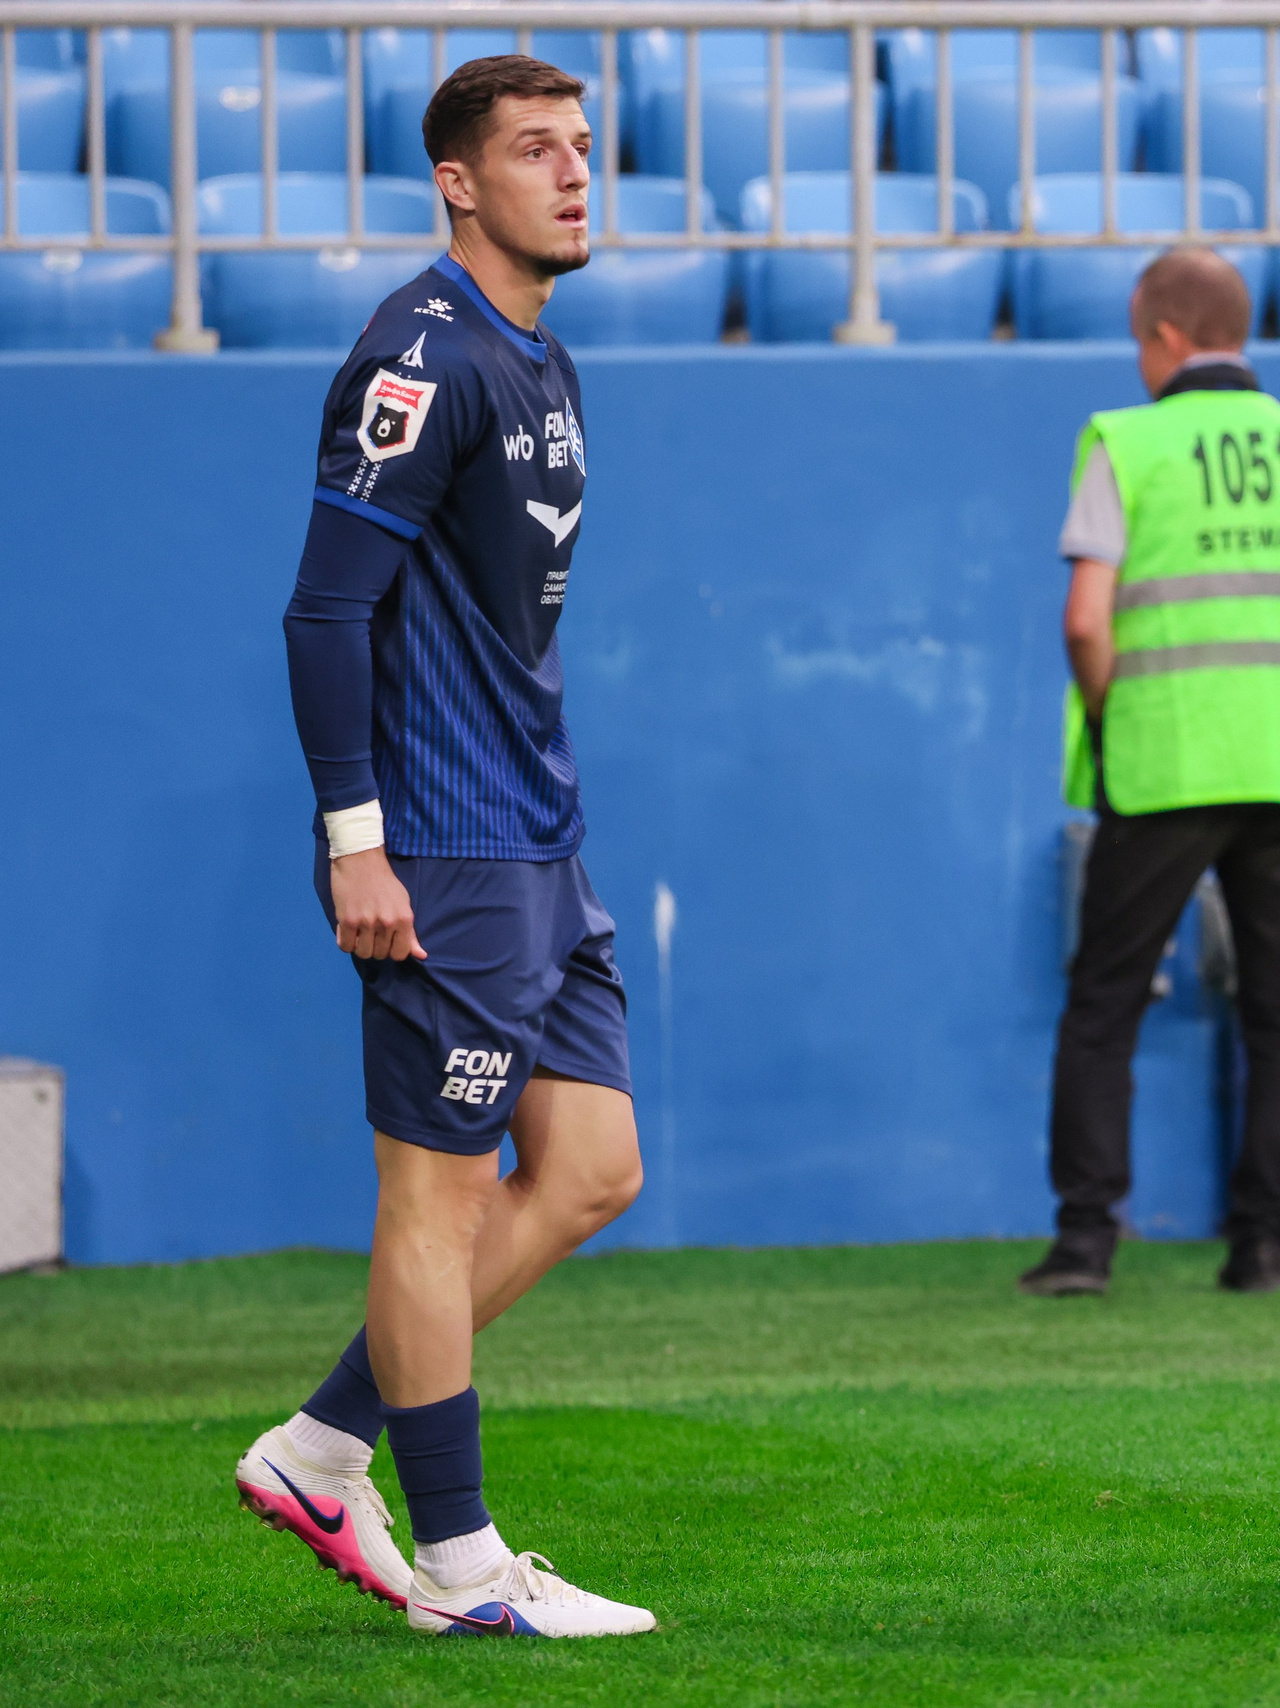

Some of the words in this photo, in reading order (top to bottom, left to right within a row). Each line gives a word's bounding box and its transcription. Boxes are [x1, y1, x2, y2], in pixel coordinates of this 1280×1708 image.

[413, 307, 455, 322] KELME
[545, 411, 566, 439] FON
[548, 440, 569, 469] BET
[540, 594, 565, 604] ОБЛАС
[444, 1048, 513, 1077] FON
[440, 1076, 508, 1104] BET
